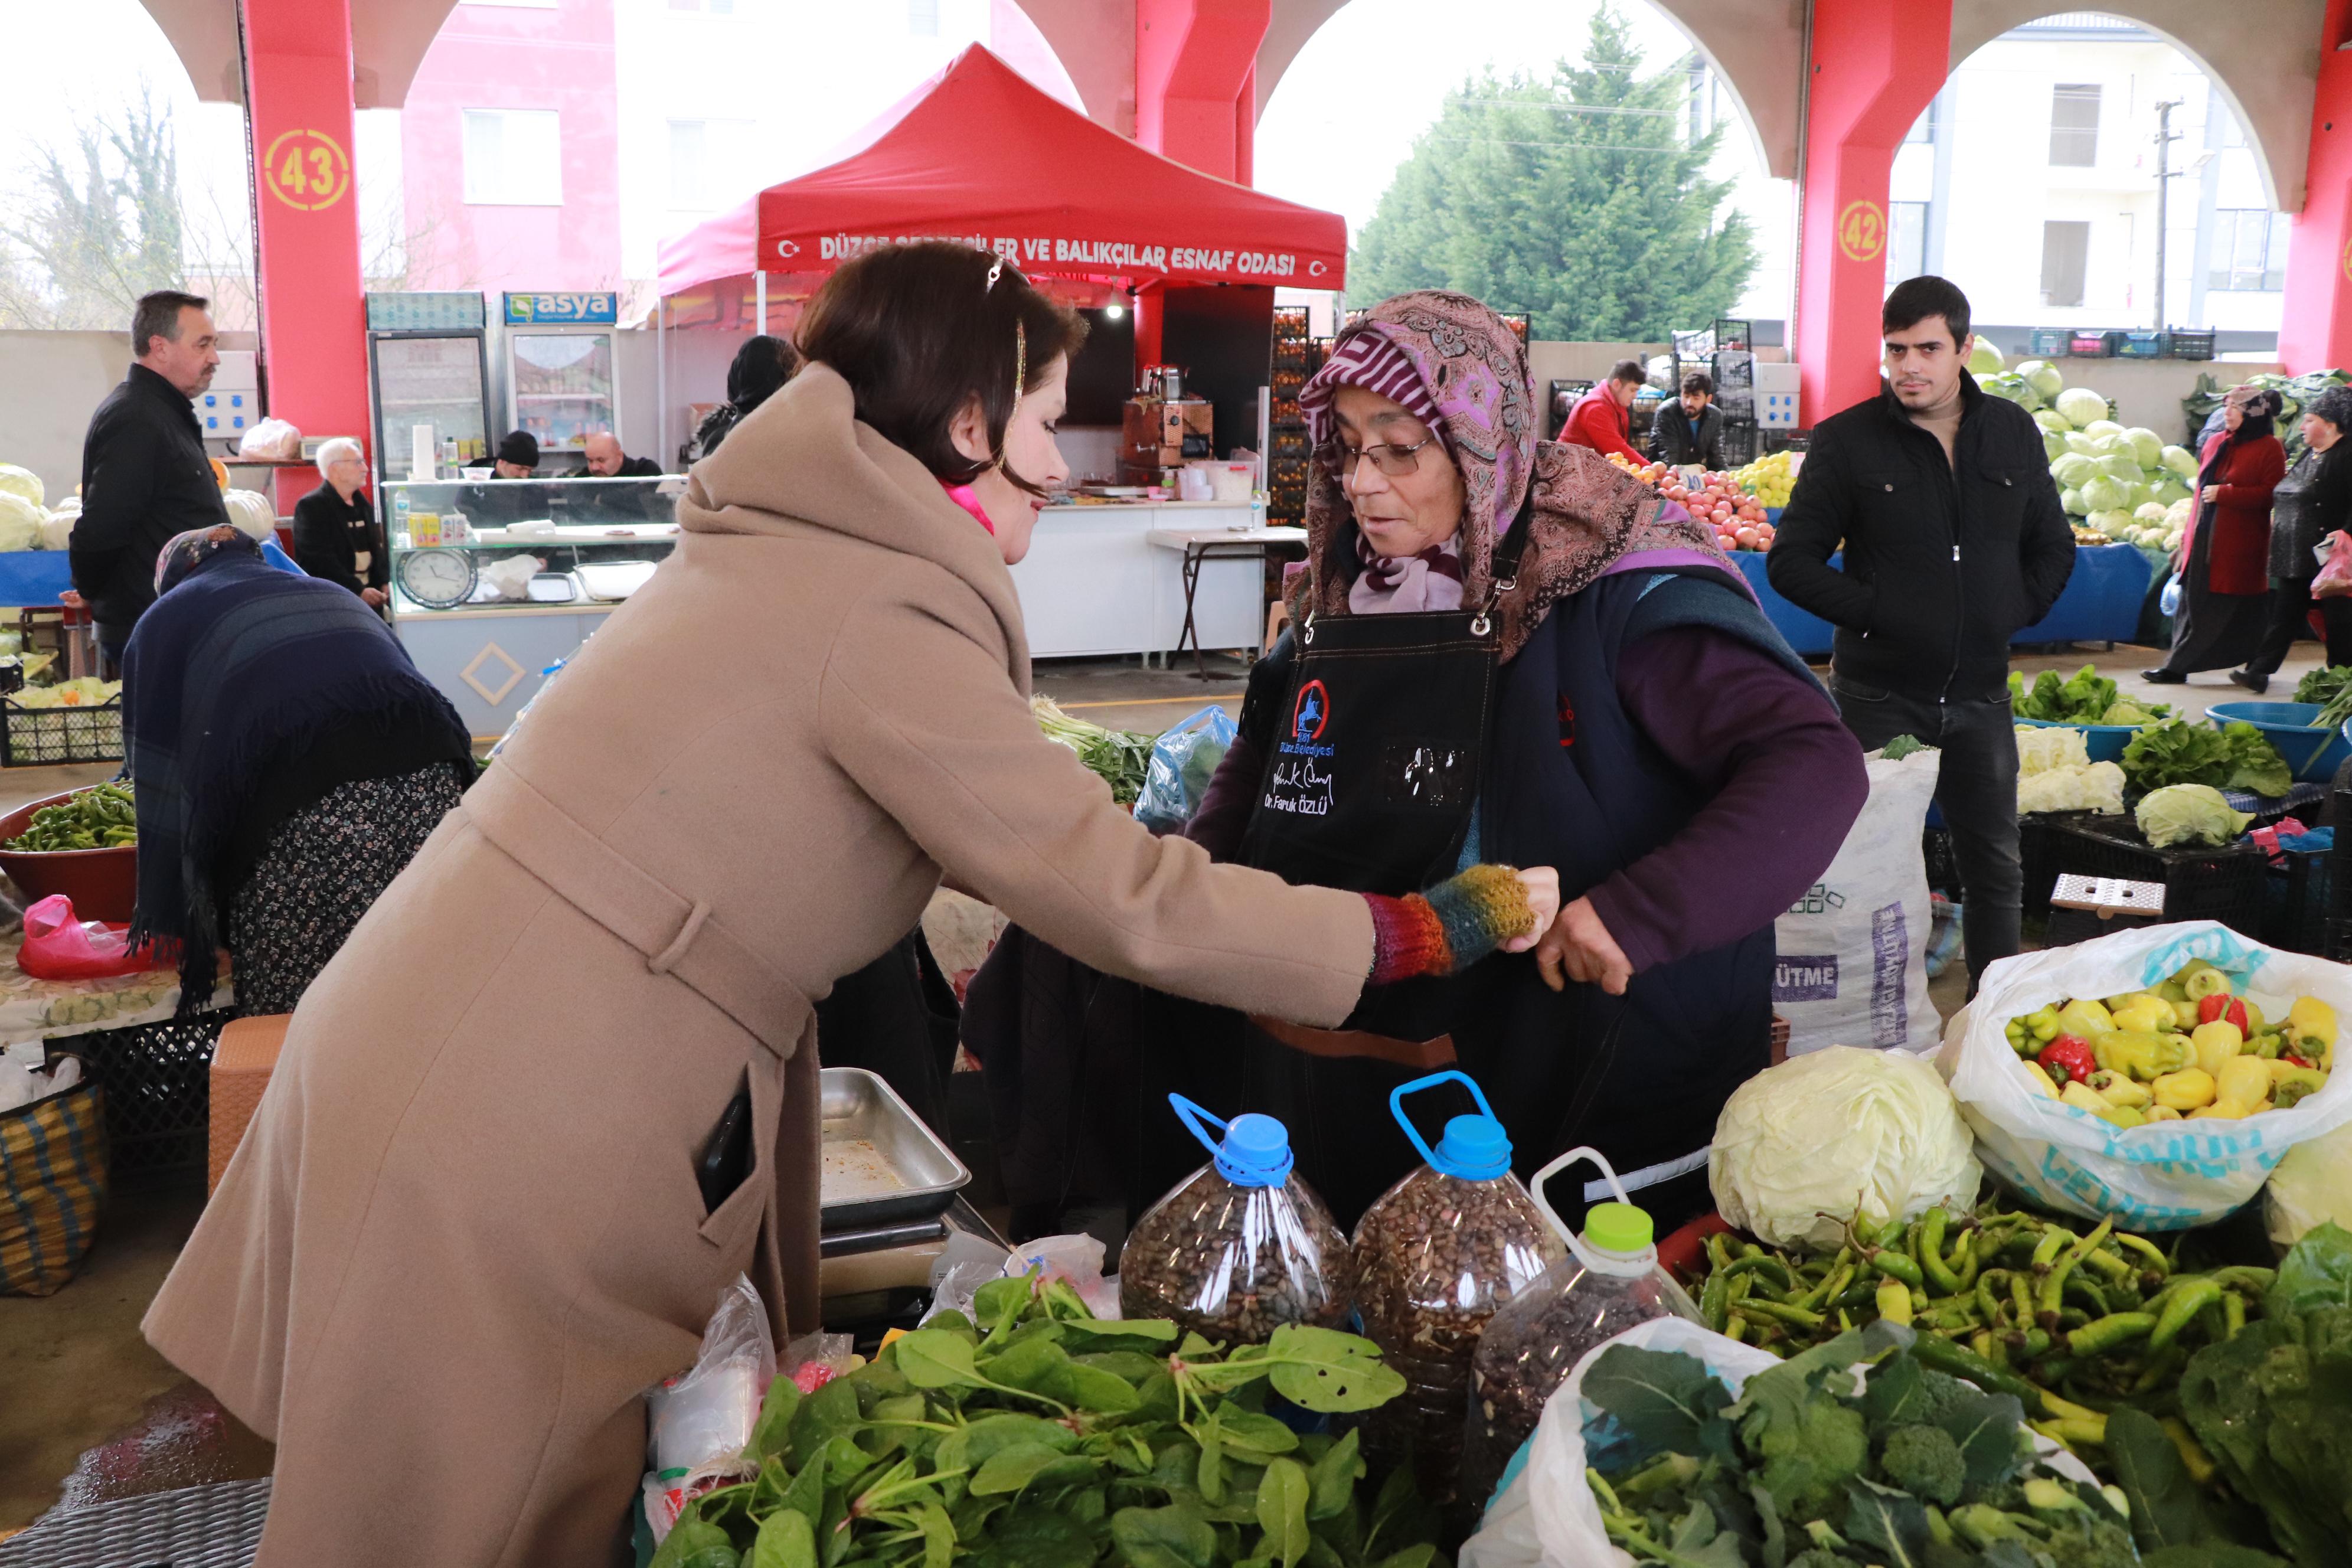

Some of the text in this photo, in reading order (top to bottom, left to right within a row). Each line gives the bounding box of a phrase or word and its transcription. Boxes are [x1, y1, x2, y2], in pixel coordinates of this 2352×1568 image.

[281, 147, 334, 195] 43
[1846, 213, 1877, 249] 42
[1023, 238, 1050, 260] VE
[1056, 239, 1167, 274] BALIKÇILAR
[1171, 248, 1235, 271] ESNAF
[1237, 252, 1296, 276] ODASI
[537, 295, 609, 319] asya
[1295, 743, 1334, 757] Belediyesi
[1273, 795, 1297, 812] Faruk
[1299, 794, 1328, 815] ÖZLÜ
[1776, 963, 1834, 988] ÜTME
